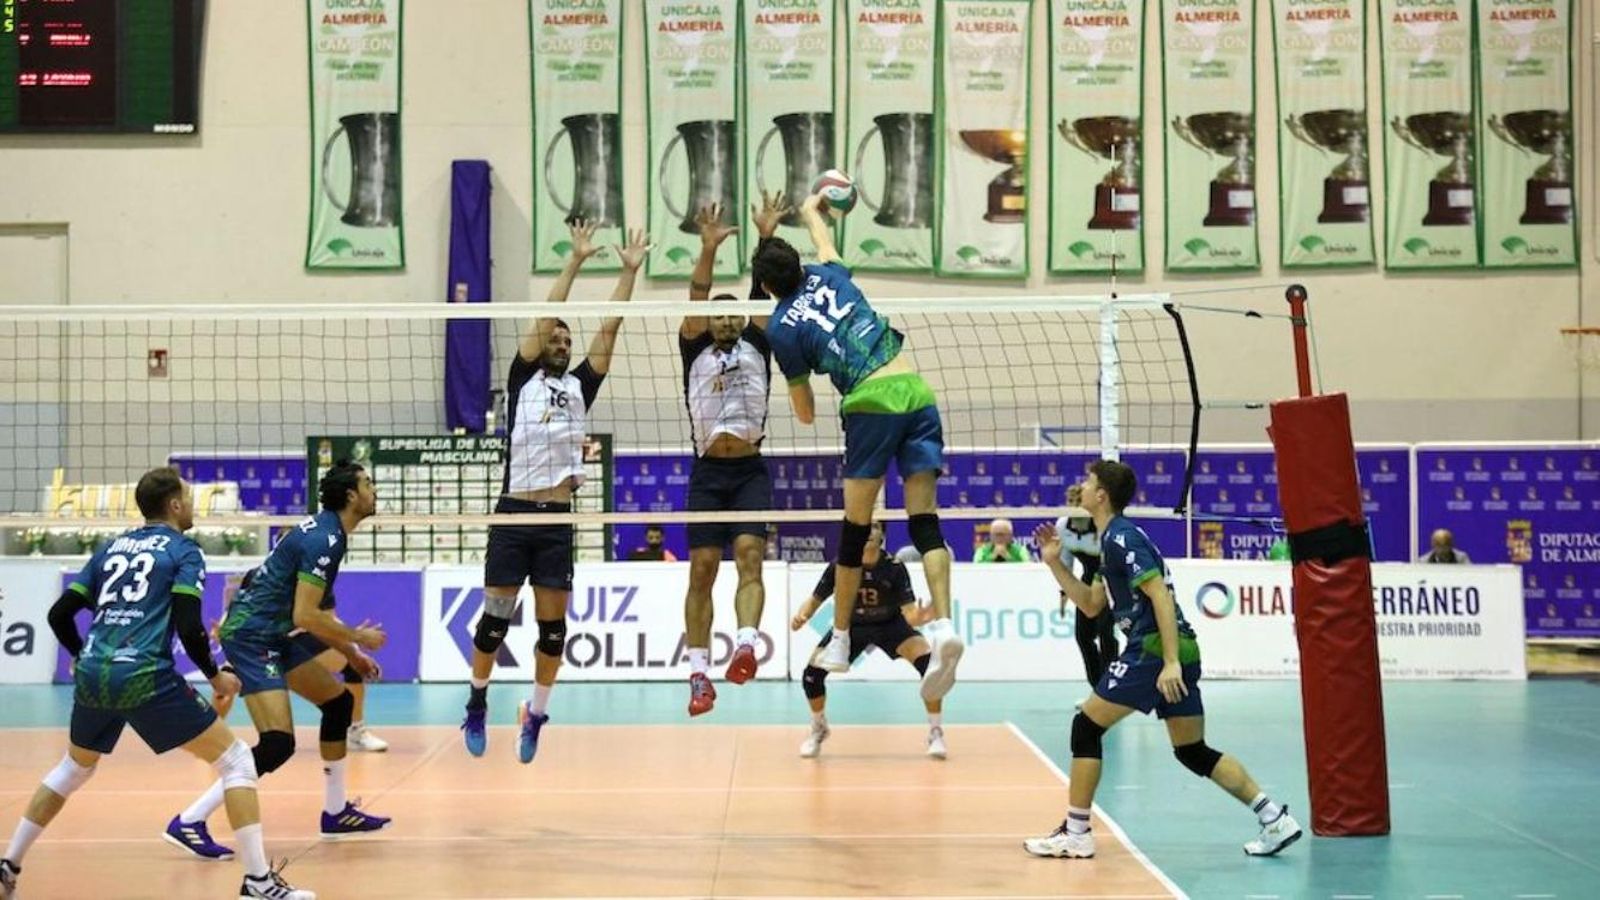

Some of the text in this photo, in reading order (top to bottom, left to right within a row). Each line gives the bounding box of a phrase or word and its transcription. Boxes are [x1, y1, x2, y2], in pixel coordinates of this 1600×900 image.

[661, 6, 721, 16] UNICAJA
[957, 7, 1016, 17] UNICAJA
[1067, 1, 1127, 11] UNICAJA
[885, 249, 917, 259] Unicaja
[801, 285, 856, 334] 12
[379, 438, 453, 451] SUPERLIGA
[456, 438, 475, 451] DE
[420, 451, 500, 464] MASCULINA
[1231, 534, 1289, 548] DIPUTA
[1541, 549, 1562, 562] DE
[97, 552, 155, 606] 23
[566, 586, 640, 622] UIZ
[1239, 586, 1286, 616] HLA
[105, 608, 145, 619] Fundación
[1417, 621, 1482, 637] PRIORIDAD
[564, 632, 775, 668] OLLADO
